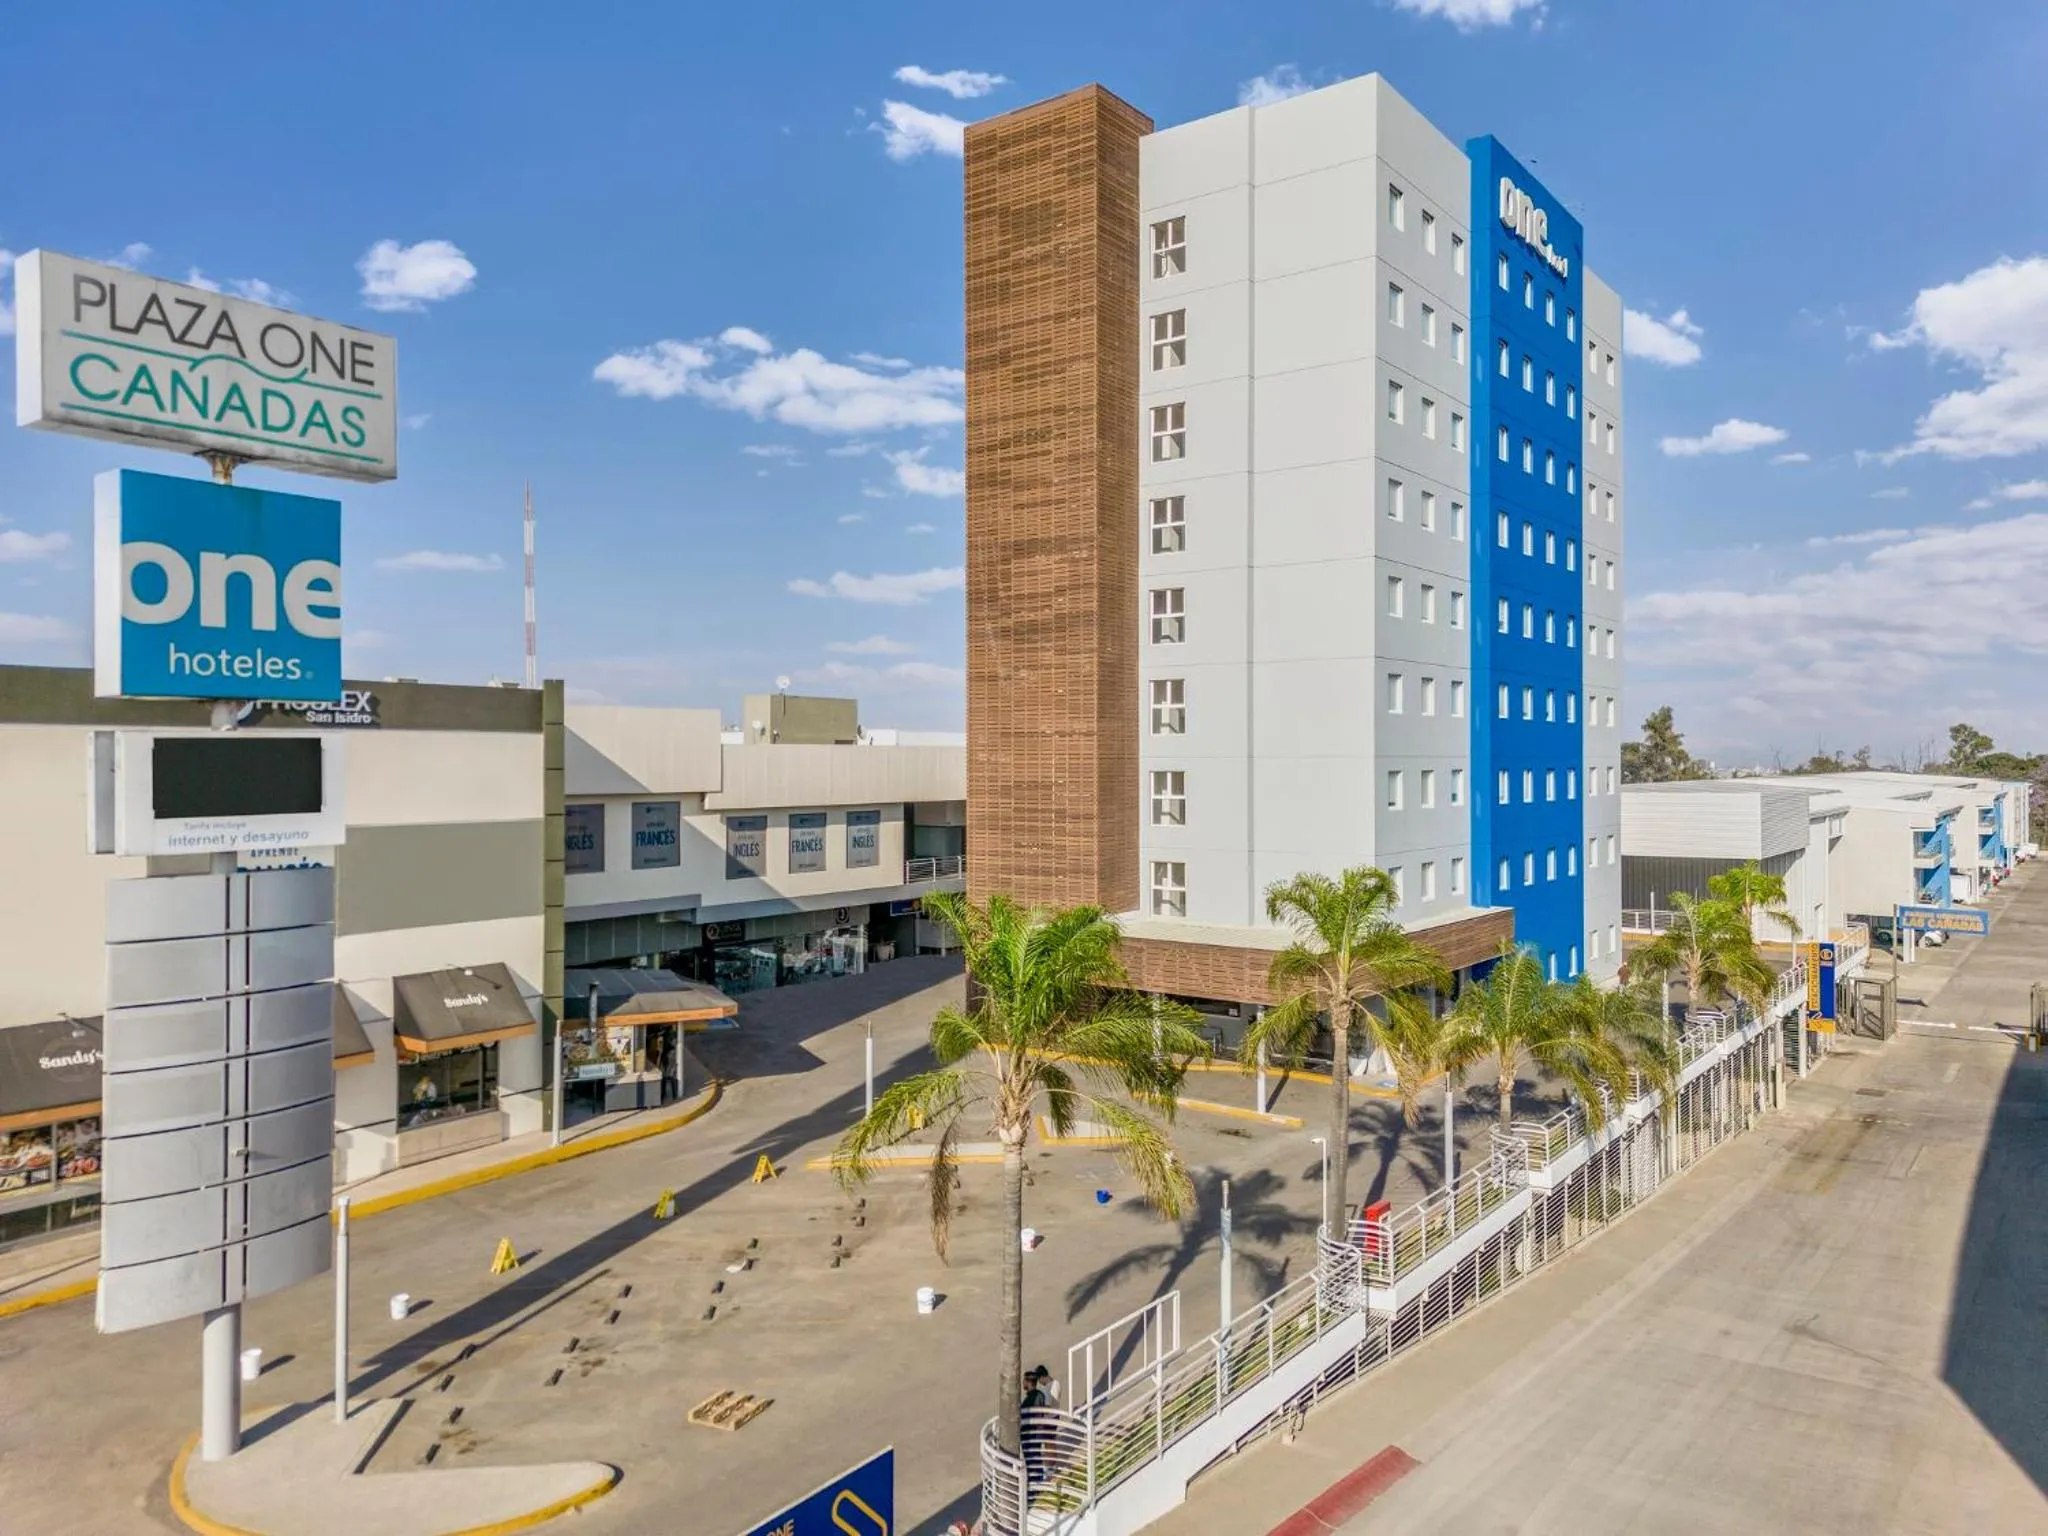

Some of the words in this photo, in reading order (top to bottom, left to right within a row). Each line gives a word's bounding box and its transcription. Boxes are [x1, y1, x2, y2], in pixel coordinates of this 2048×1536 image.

[1499, 177, 1548, 257] one
[72, 273, 247, 358] PLAZA
[259, 322, 376, 387] ONE
[121, 540, 341, 640] one
[168, 642, 302, 681] hoteles
[305, 711, 332, 723] San
[335, 712, 371, 723] Isidro
[168, 833, 225, 848] internet
[229, 834, 239, 847] y
[242, 828, 310, 844] desayuno
[444, 993, 488, 1009] Sandy's
